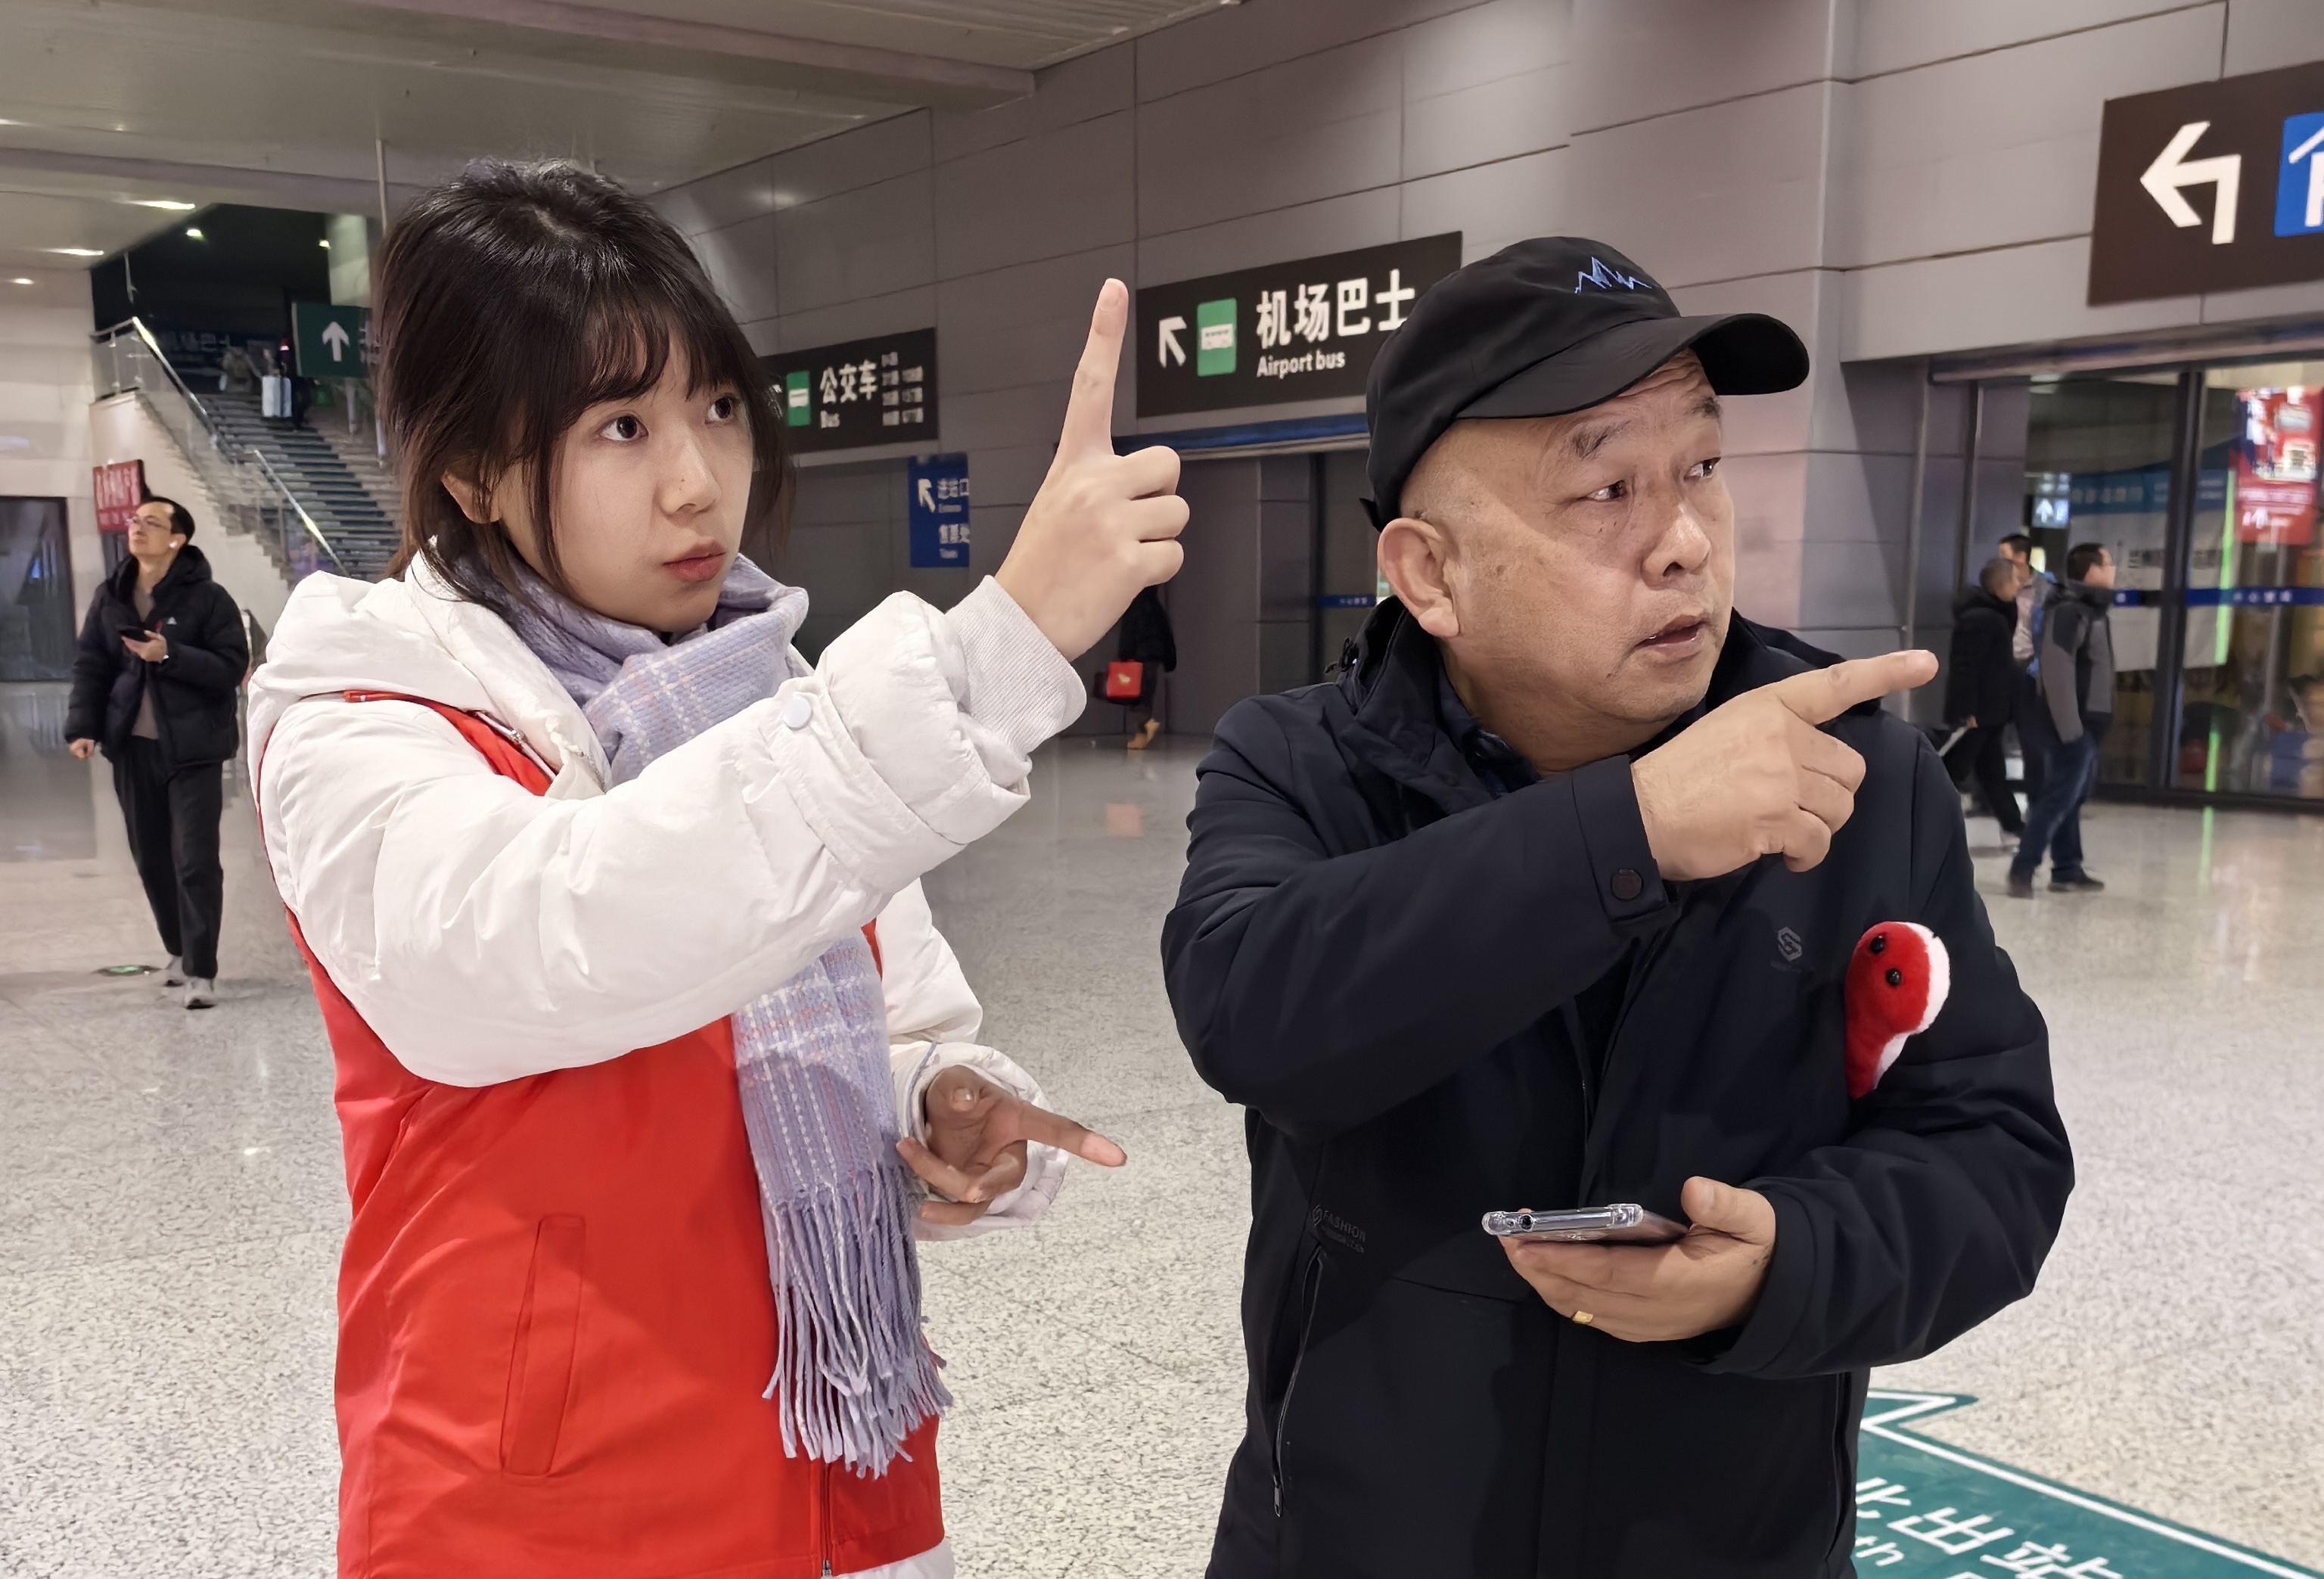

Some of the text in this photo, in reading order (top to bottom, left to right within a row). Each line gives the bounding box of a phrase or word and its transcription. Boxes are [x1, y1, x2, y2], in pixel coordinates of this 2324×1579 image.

[1256, 269, 1415, 350] 机场巴士
[819, 359, 878, 404] 公交车
[1257, 349, 1345, 380] Airport bus
